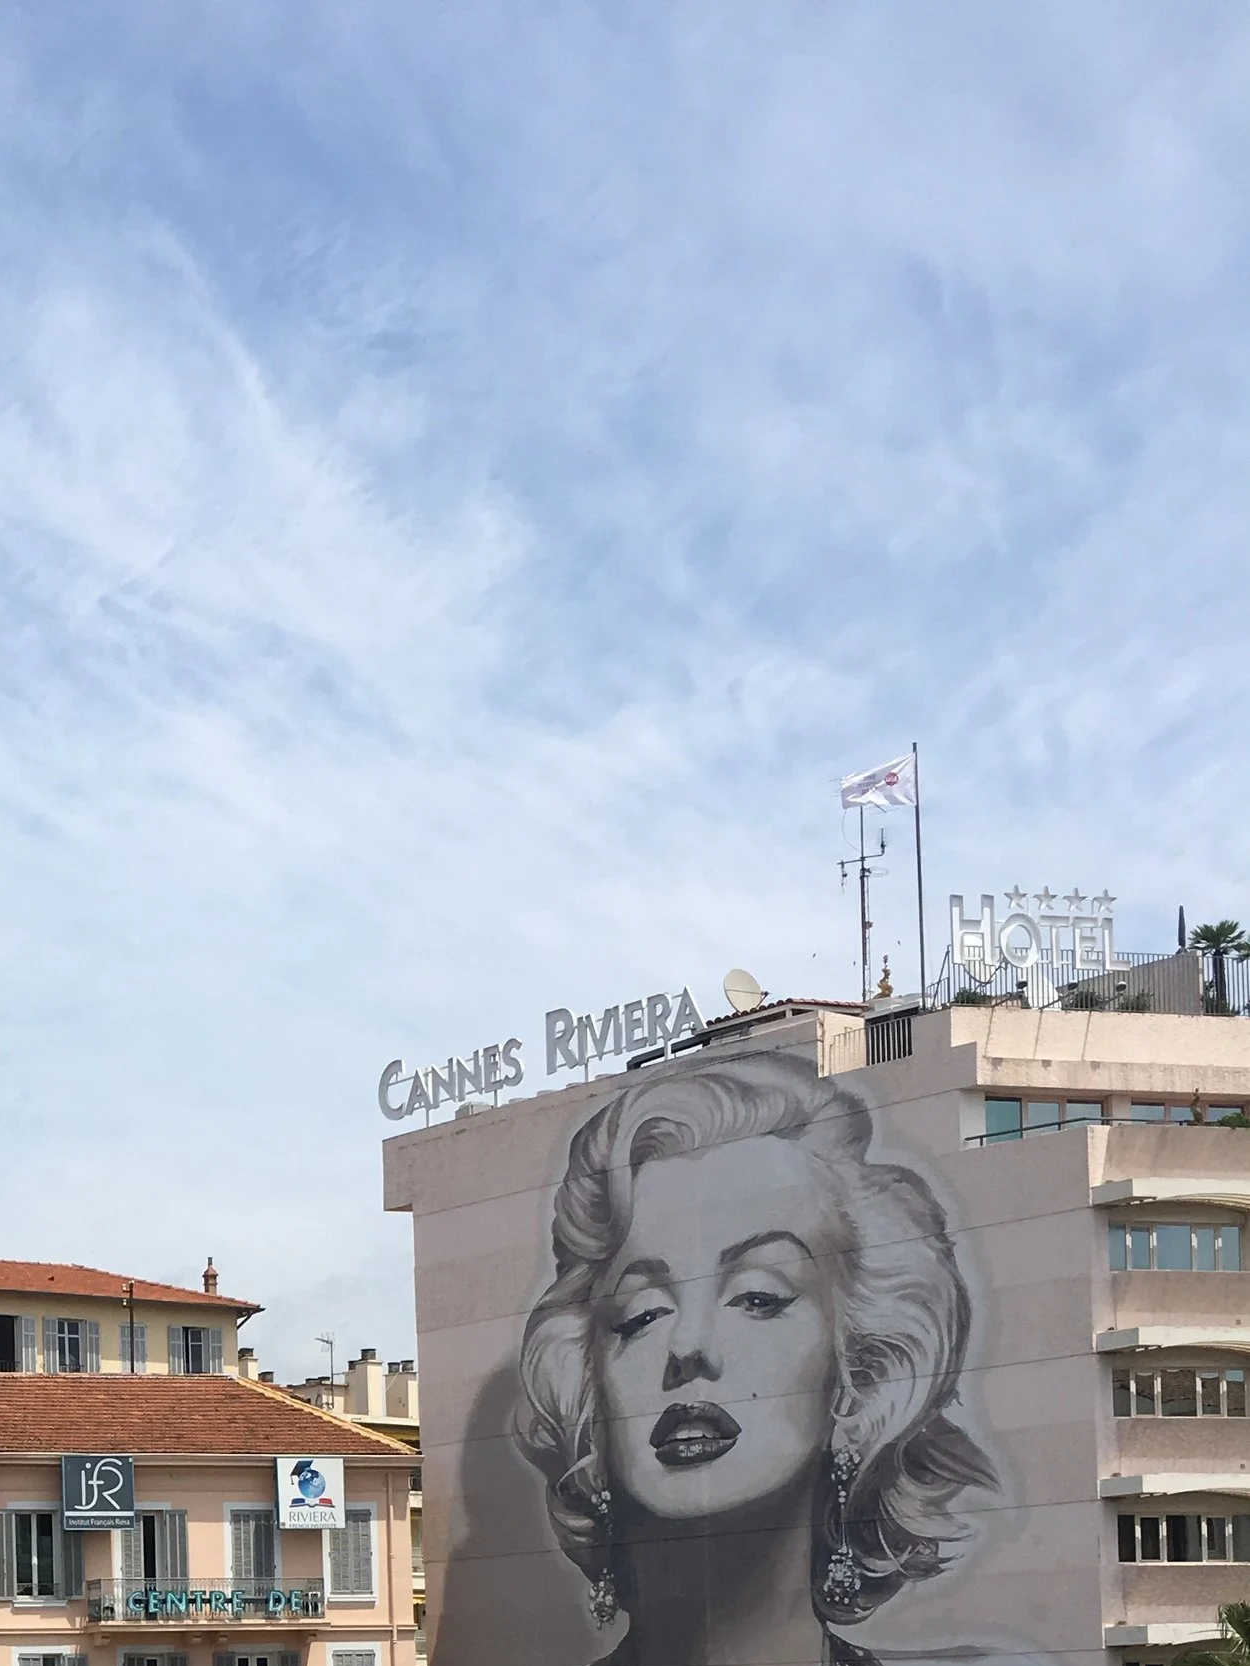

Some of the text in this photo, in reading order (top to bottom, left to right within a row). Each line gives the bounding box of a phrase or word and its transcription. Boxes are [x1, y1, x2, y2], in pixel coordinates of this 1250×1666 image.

[289, 1511, 337, 1522] RIVIERA
[127, 1590, 303, 1613] CENTRE DE
